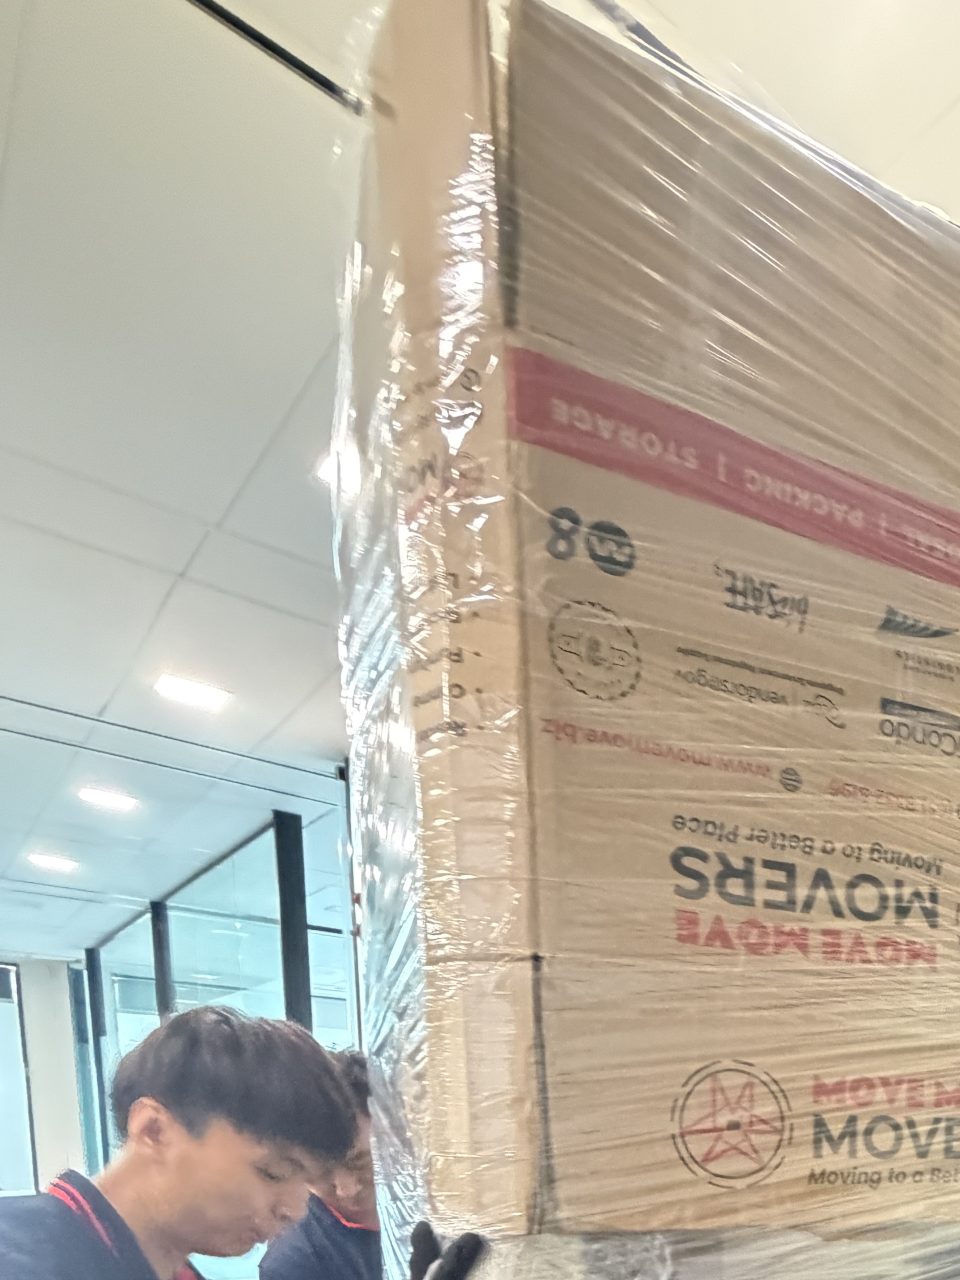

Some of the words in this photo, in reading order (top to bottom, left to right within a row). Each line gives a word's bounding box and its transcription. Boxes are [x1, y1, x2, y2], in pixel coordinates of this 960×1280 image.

[551, 397, 699, 470] STORAGE
[744, 467, 864, 528] PACKING
[672, 814, 740, 843] Place
[747, 827, 815, 856] Better
[822, 840, 836, 856] a
[841, 843, 863, 863] to
[870, 841, 944, 876] Moving
[669, 845, 940, 929] MOVERS
[675, 908, 810, 957] MOVE
[820, 928, 938, 969] MOVE
[812, 1074, 925, 1108] MOVE
[807, 1166, 882, 1190] Moving
[888, 1168, 907, 1184] to
[912, 1170, 925, 1184] a
